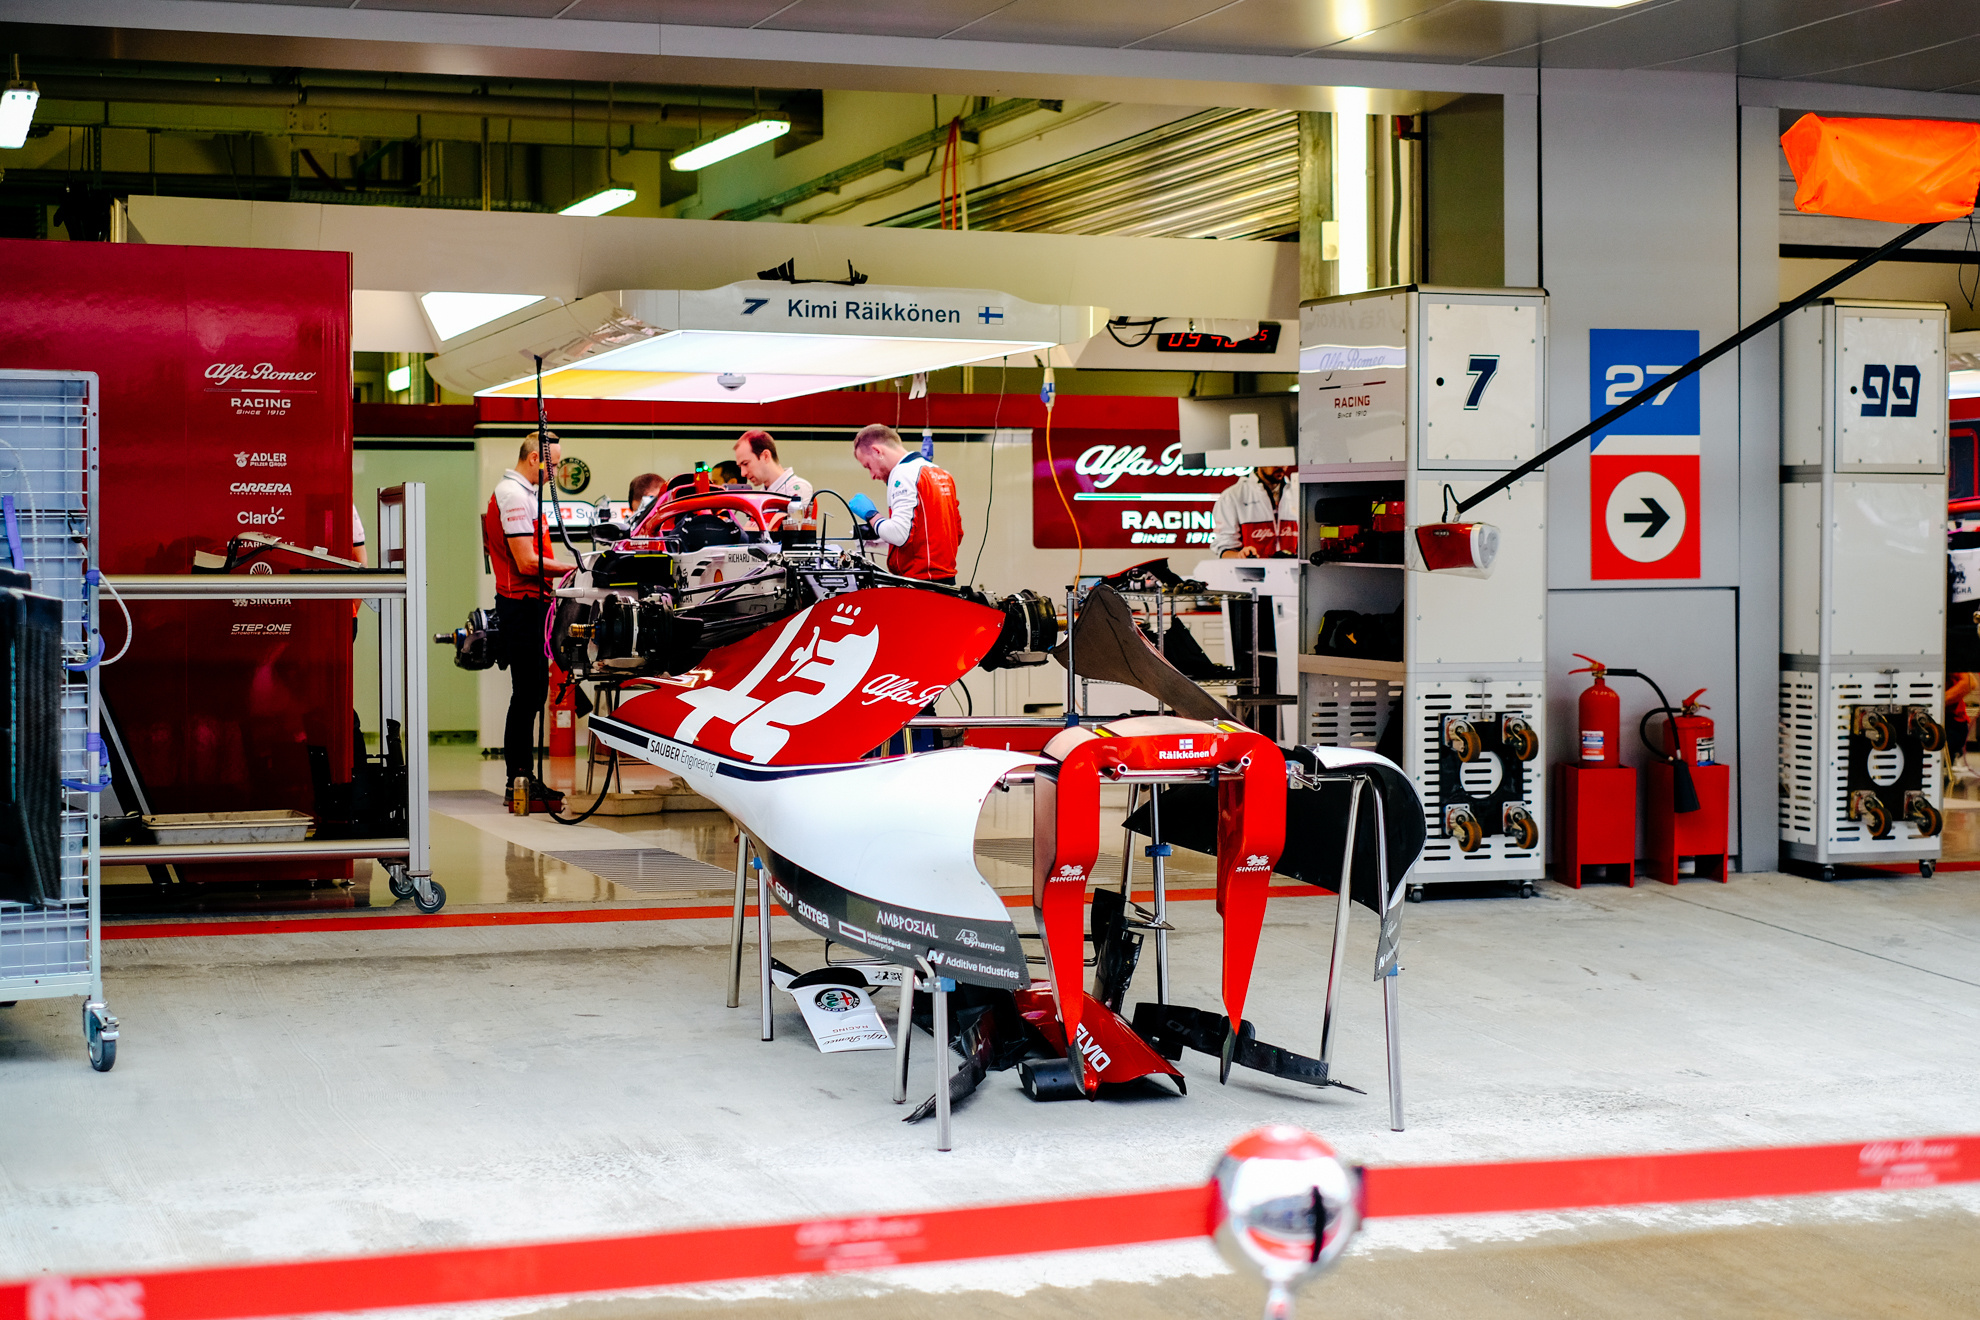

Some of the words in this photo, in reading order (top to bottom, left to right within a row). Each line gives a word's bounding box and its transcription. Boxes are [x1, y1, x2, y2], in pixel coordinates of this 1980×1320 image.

[740, 297, 770, 315] 7
[788, 299, 838, 319] Kimi
[845, 301, 961, 323] Räikkönen
[1320, 351, 1345, 382] Alfa
[1346, 348, 1386, 370] Romeo
[204, 363, 251, 386] Alfa
[250, 362, 317, 381] Romeo
[1463, 354, 1500, 410] 7
[1605, 364, 1685, 406] 27
[1860, 363, 1921, 417] 99
[230, 398, 292, 408] RACING
[1334, 395, 1371, 409] RACING
[250, 453, 287, 462] ADLER
[1075, 444, 1158, 489] Alfa
[229, 482, 292, 493] CARRERA
[237, 510, 278, 525] Claro
[1121, 510, 1216, 529] RACIN
[861, 674, 919, 706] Alfa
[650, 740, 681, 762] SAUBER
[680, 750, 716, 777] Engineering
[1158, 750, 1210, 760] Räikkönen
[1236, 865, 1271, 873] SINGHA
[1050, 874, 1086, 883] SINGHA
[867, 931, 888, 944] Hewlett
[888, 937, 911, 950] Packard
[867, 938, 895, 952] Enterprise
[963, 937, 1006, 953] Dynamics
[946, 956, 978, 972] Additive
[978, 963, 1020, 979] Industries
[832, 1025, 869, 1033] RACING
[823, 1034, 862, 1046] Romeo
